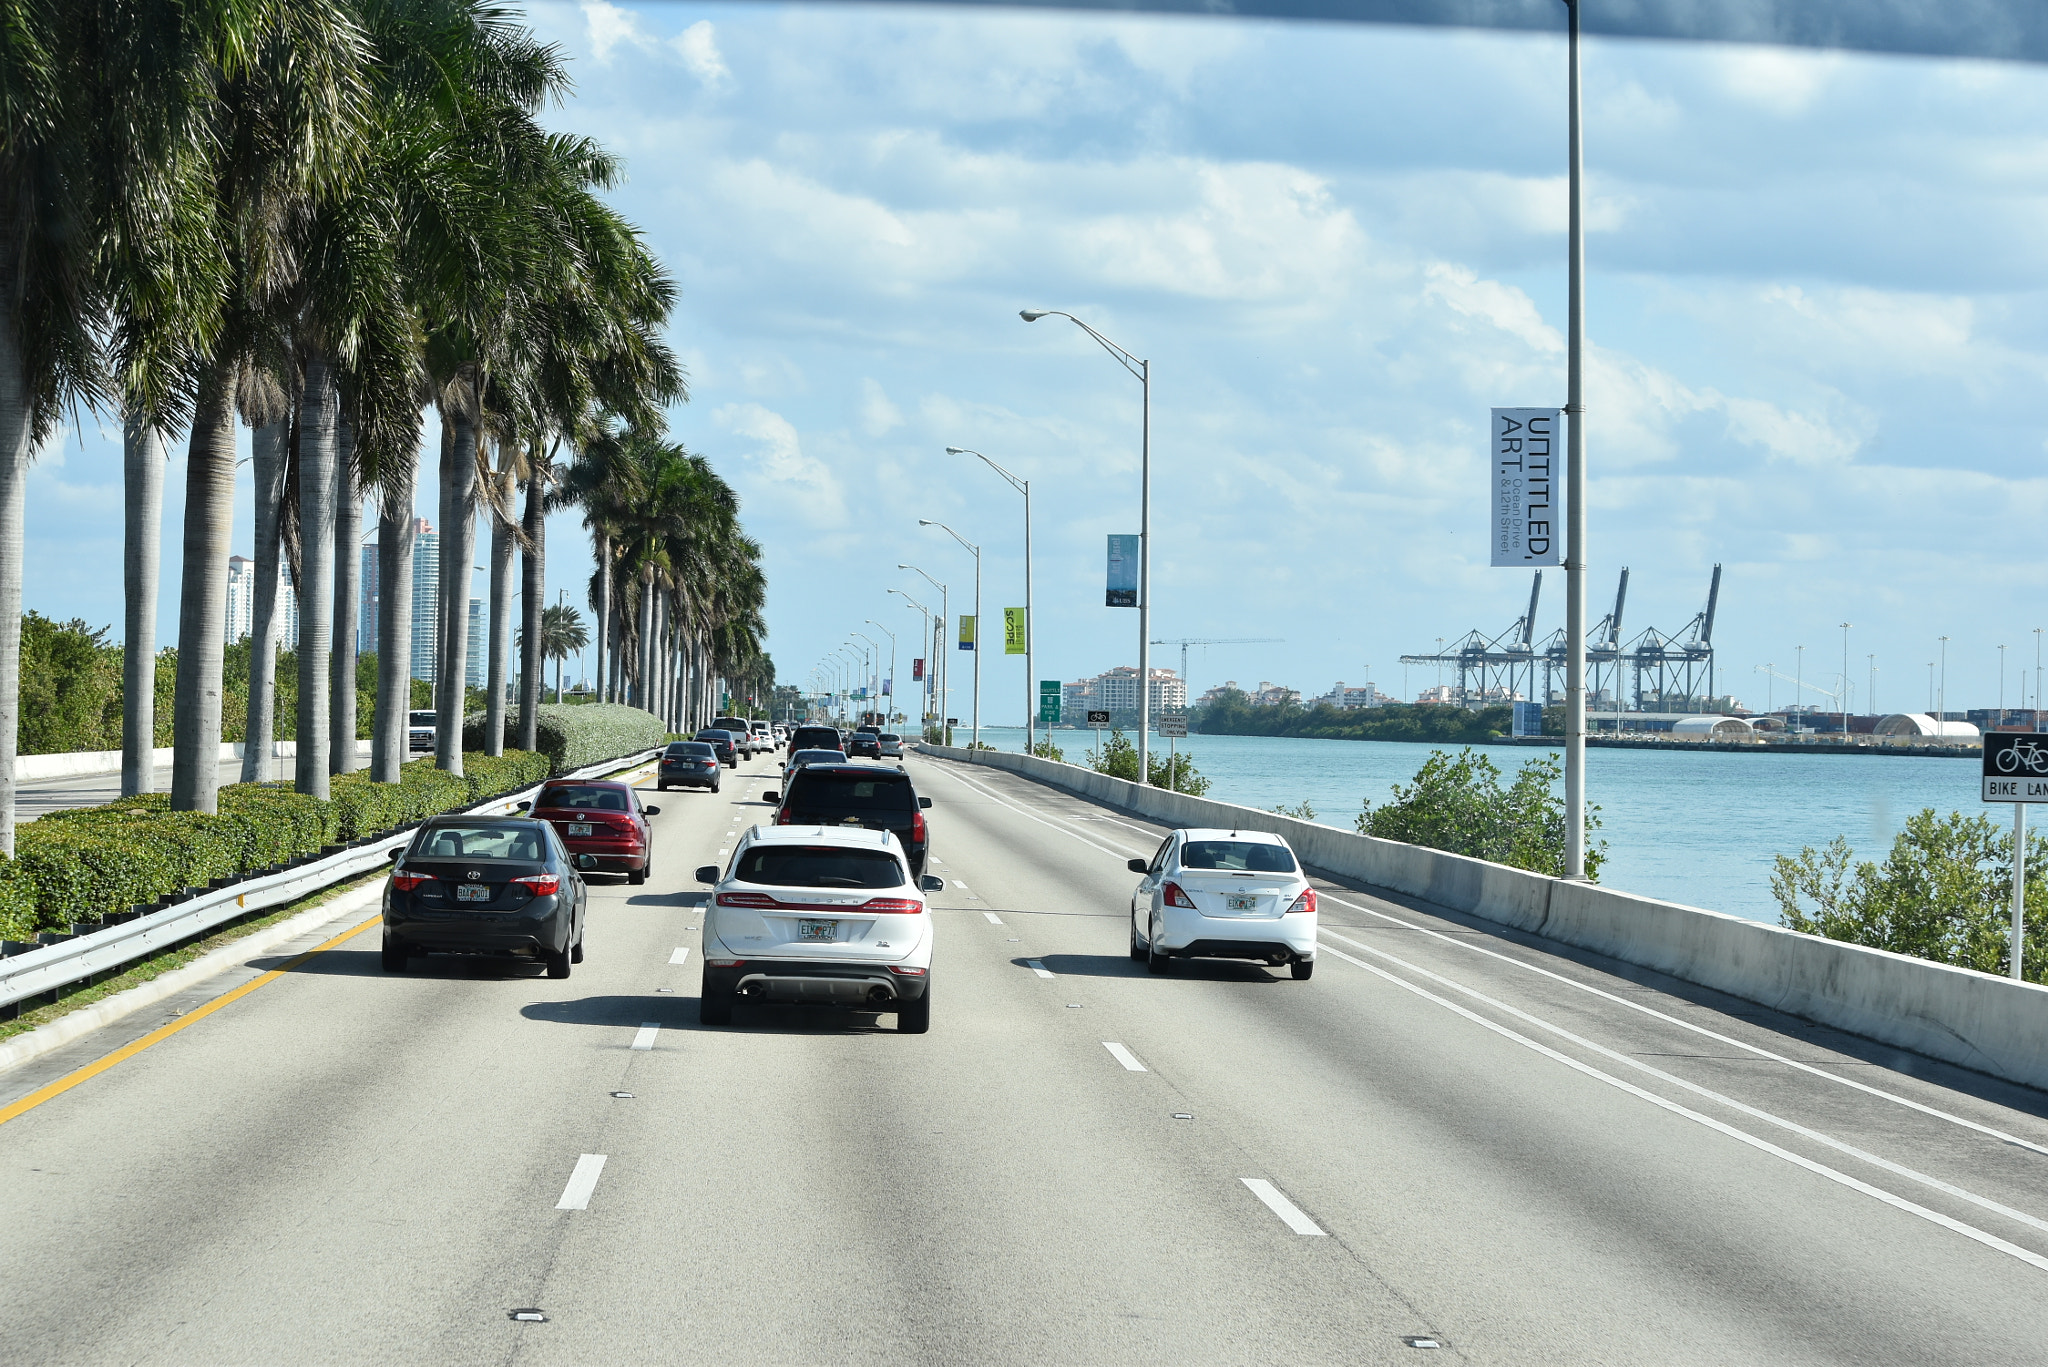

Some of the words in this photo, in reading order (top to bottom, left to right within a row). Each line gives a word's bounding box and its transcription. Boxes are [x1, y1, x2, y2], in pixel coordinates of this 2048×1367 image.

[1501, 415, 1523, 475] ART.
[1500, 478, 1511, 488] &
[1500, 490, 1511, 515] 12th
[1512, 478, 1523, 516] Ocean
[1512, 518, 1523, 548] Drive
[1990, 782, 2018, 795] BIKE
[780, 896, 859, 904] LINCOLN
